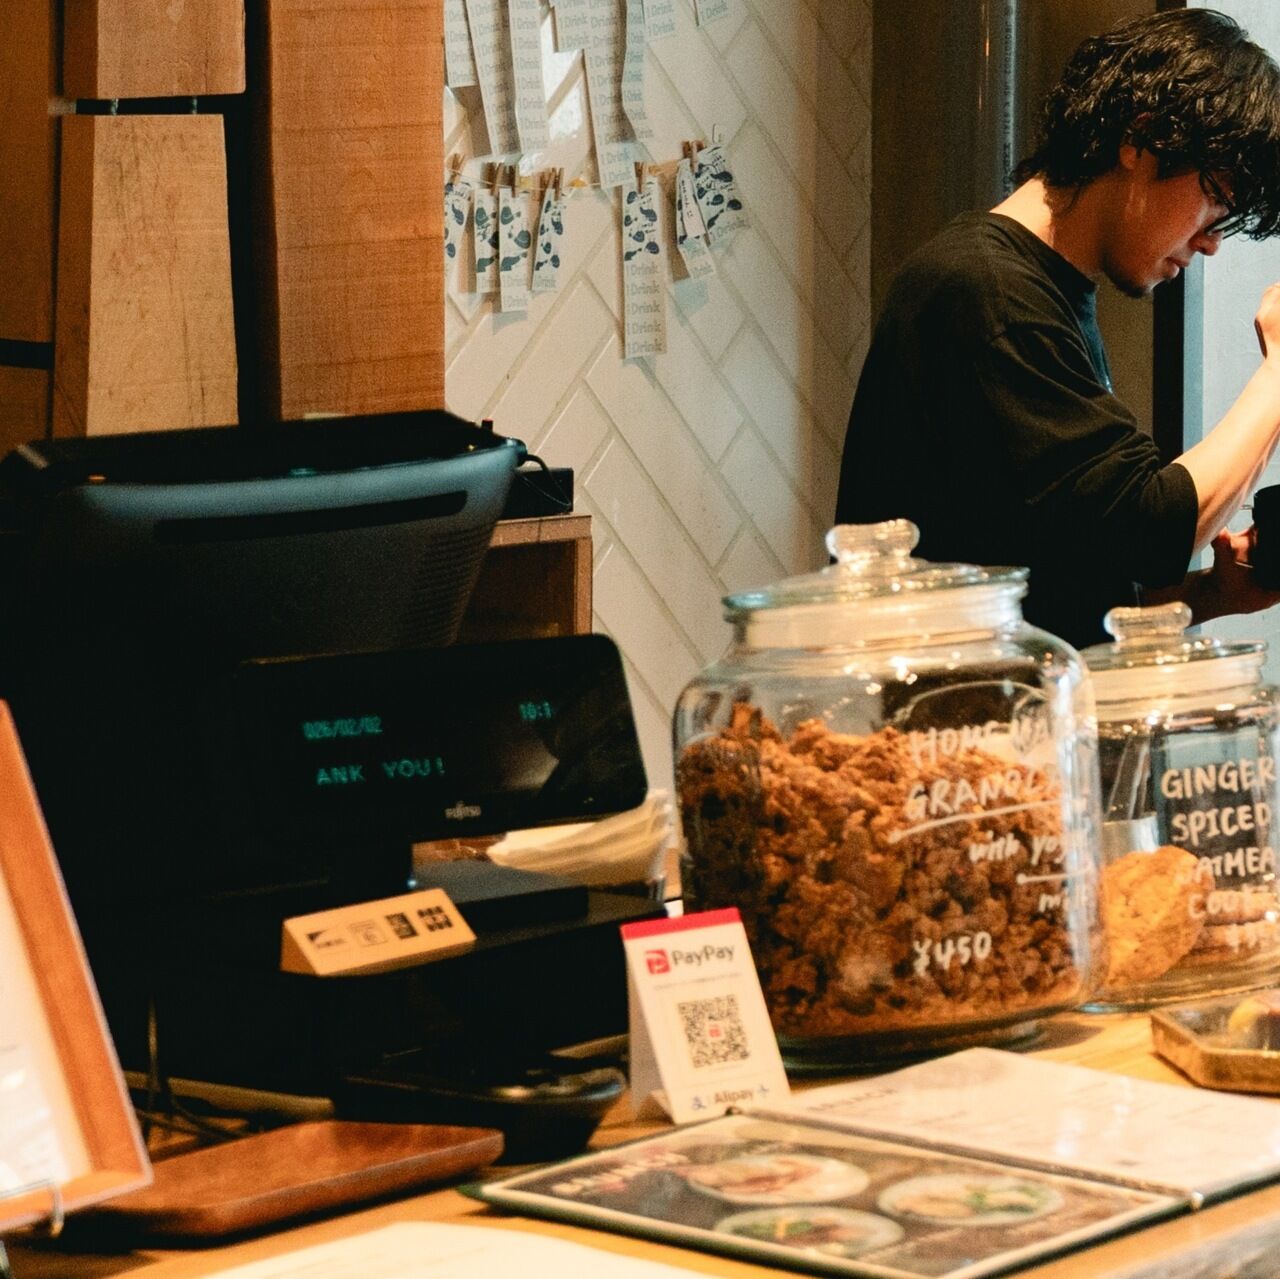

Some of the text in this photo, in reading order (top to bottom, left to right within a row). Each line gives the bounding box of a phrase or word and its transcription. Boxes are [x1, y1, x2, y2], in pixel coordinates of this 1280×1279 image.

[1160, 755, 1278, 800] GINGER
[1171, 802, 1274, 847] SPICED
[671, 945, 735, 967] PayPay
[913, 931, 993, 978] ¥450
